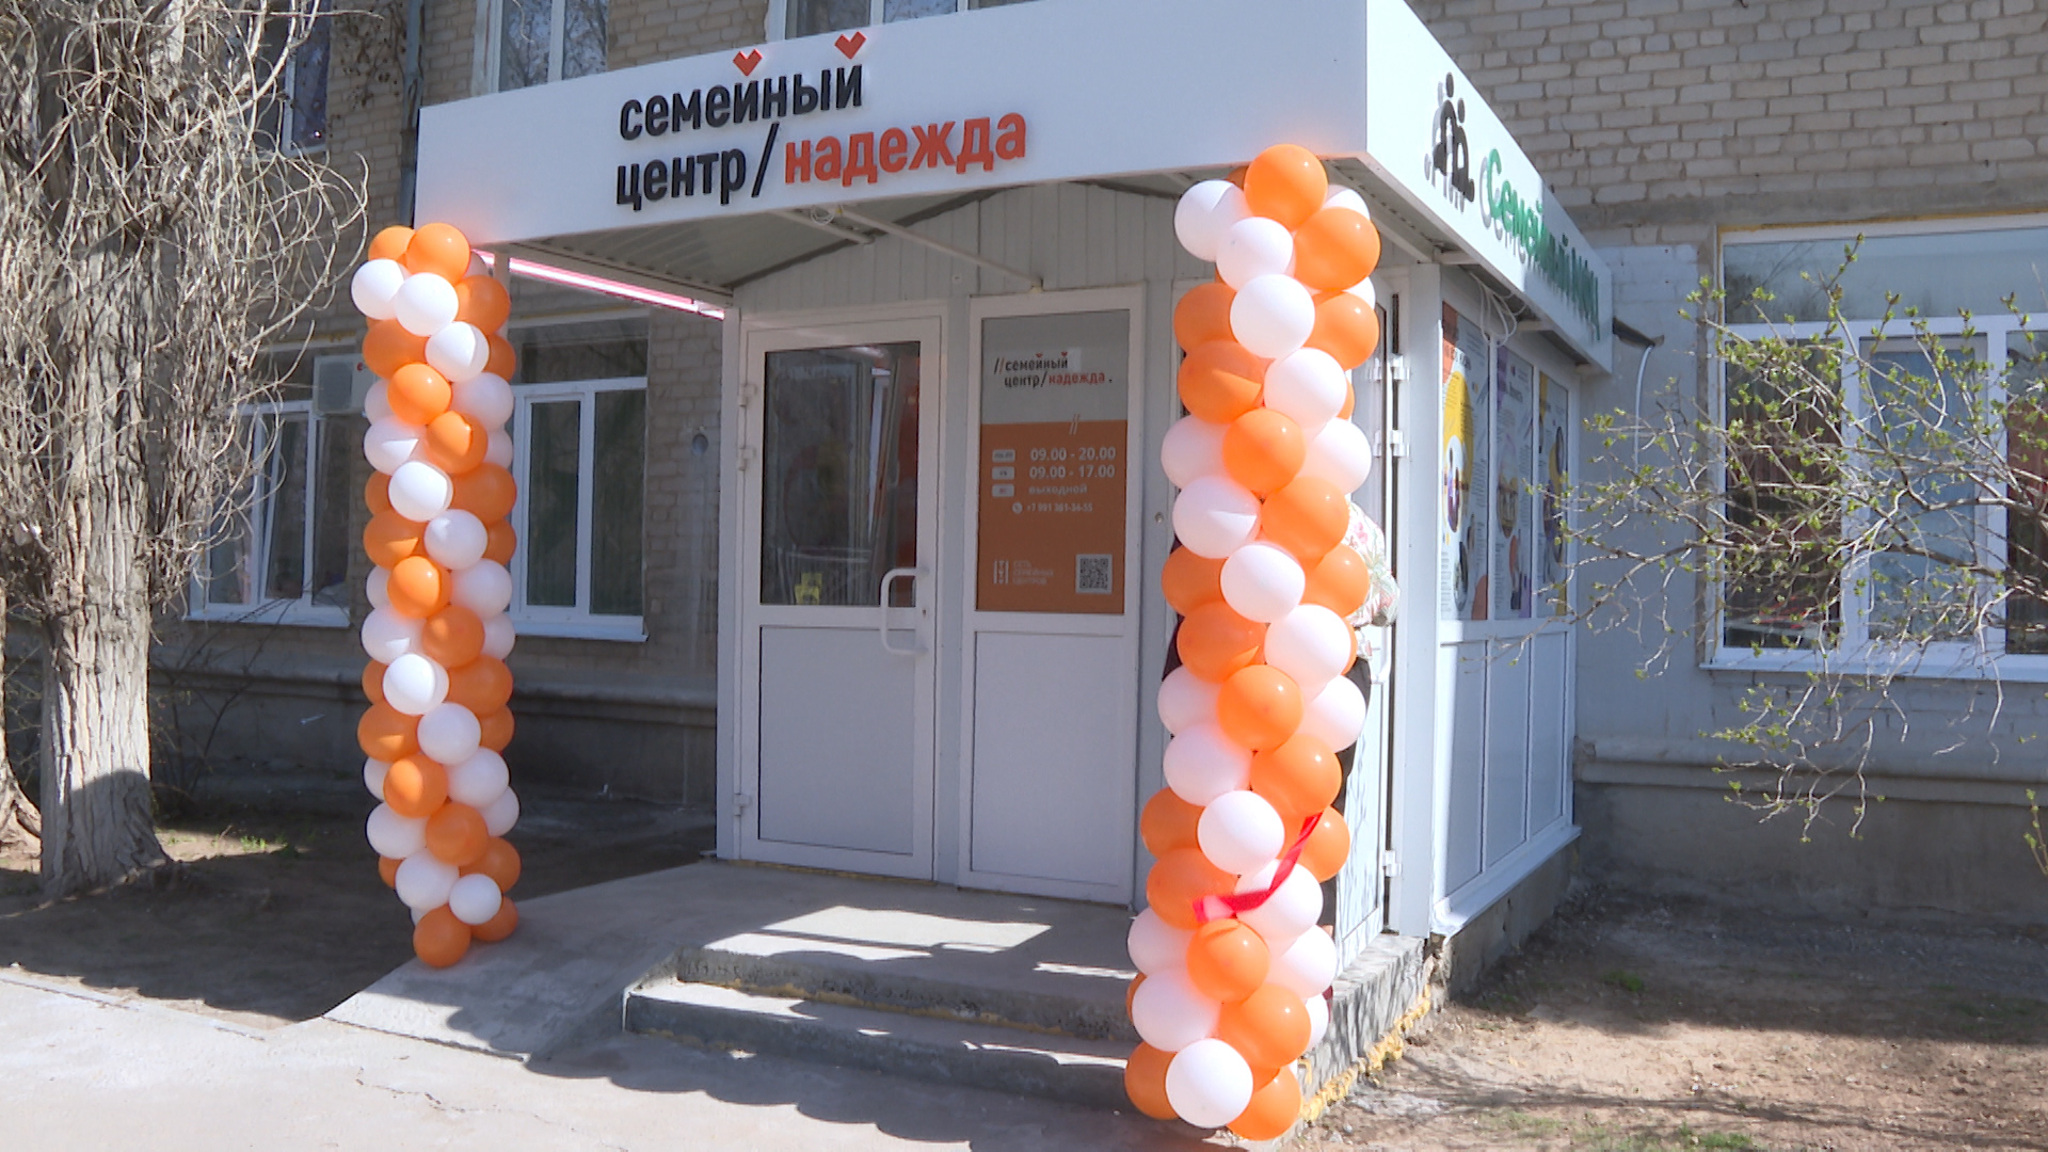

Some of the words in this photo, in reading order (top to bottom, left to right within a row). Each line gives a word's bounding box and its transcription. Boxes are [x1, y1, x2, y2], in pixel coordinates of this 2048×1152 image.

[620, 31, 866, 141] семейный
[1030, 448, 1067, 461] 09.00
[1078, 447, 1116, 461] 20.00
[1029, 466, 1066, 479] 09.00
[1078, 465, 1115, 478] 17.00
[1028, 483, 1087, 496] выходной
